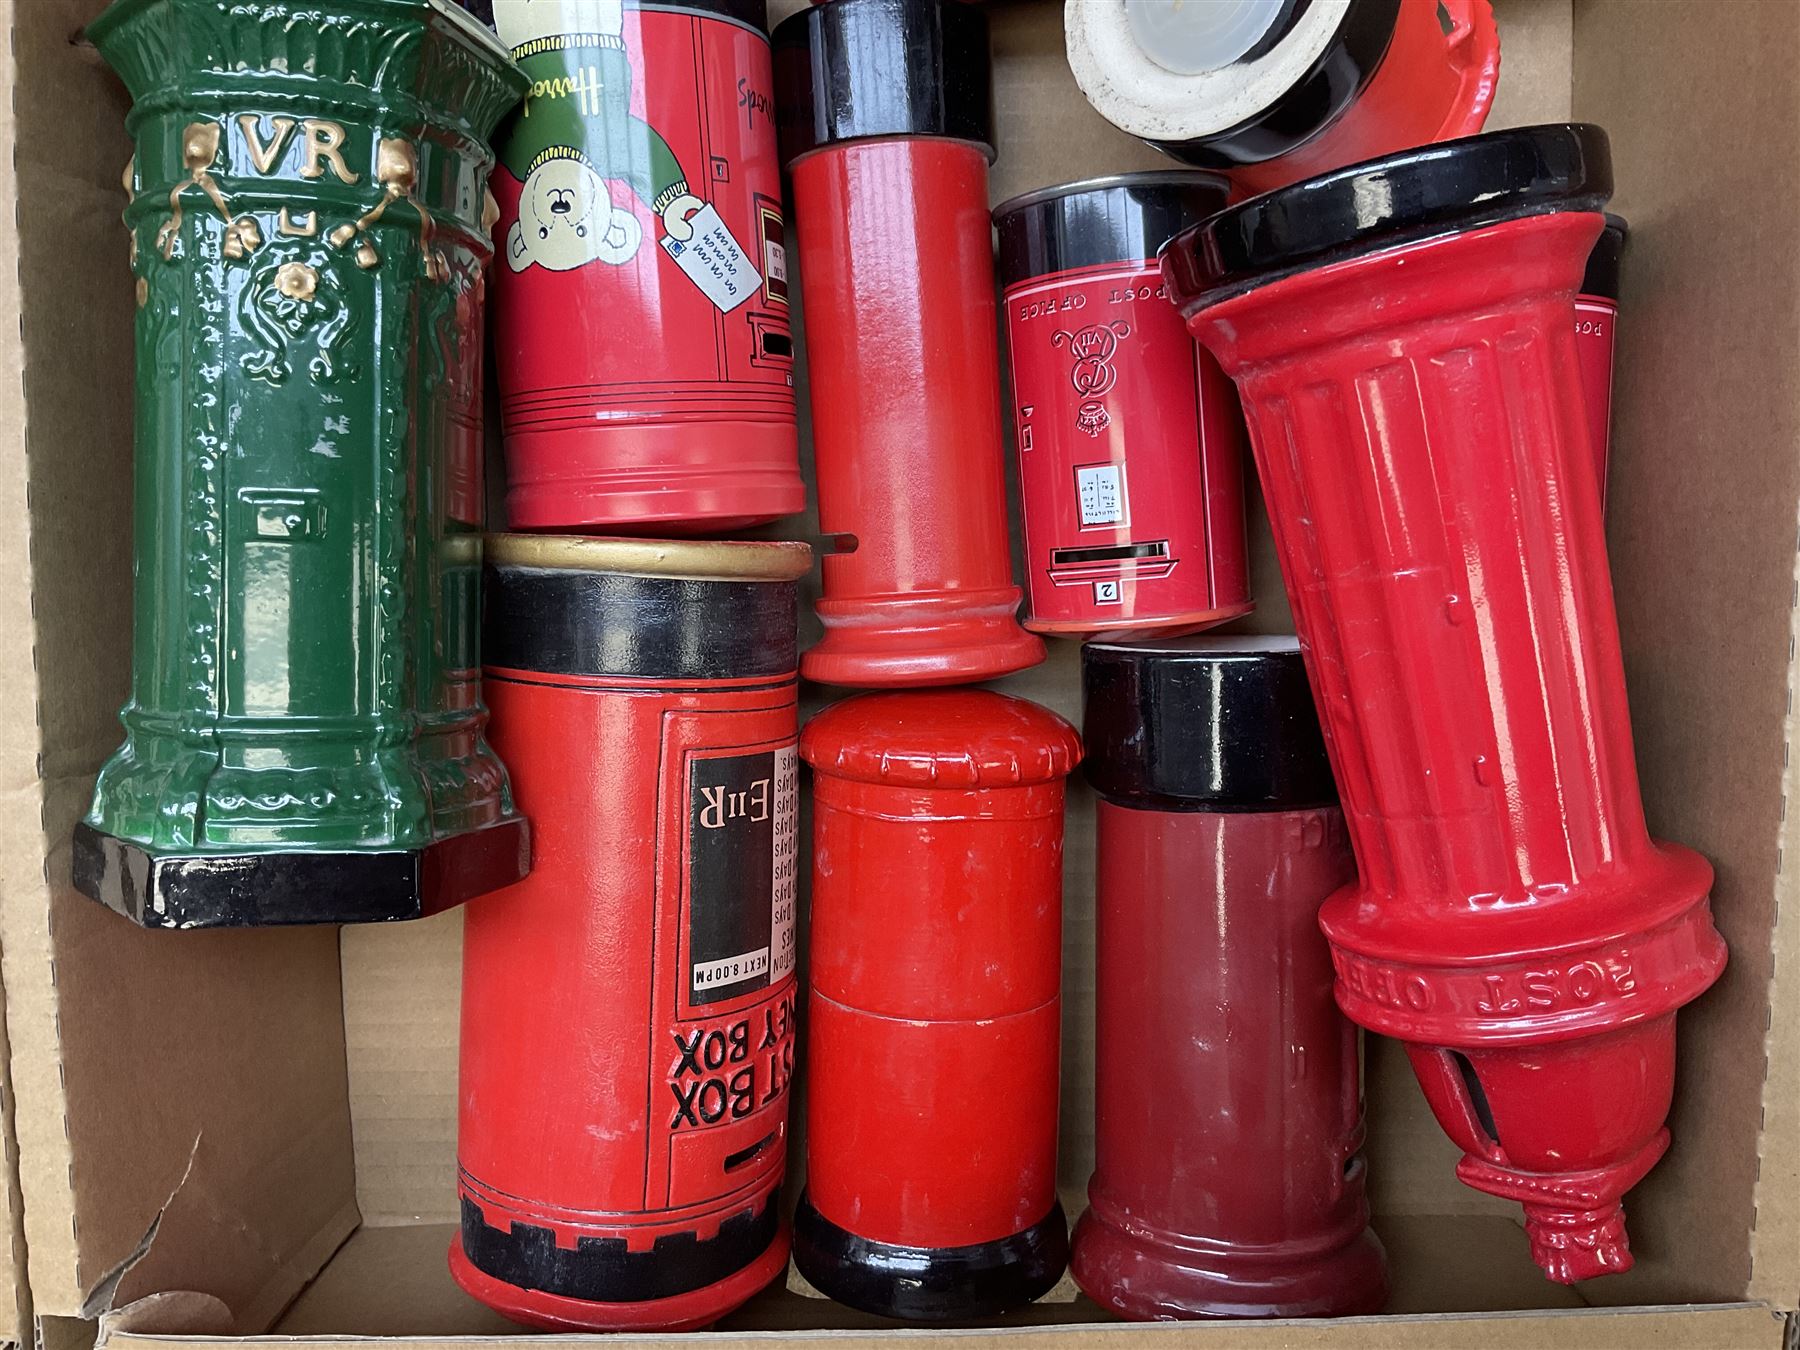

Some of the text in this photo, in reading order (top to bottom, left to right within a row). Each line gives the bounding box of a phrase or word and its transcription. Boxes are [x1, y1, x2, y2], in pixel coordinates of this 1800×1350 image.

[238, 113, 359, 185] VR
[1019, 283, 1166, 322] POST OFFICE
[1101, 583, 1112, 598] 2
[743, 954, 767, 974] NEXT
[1478, 950, 1637, 1017] POST
[673, 1020, 749, 1079] BOX
[670, 1065, 755, 1130] BOX
